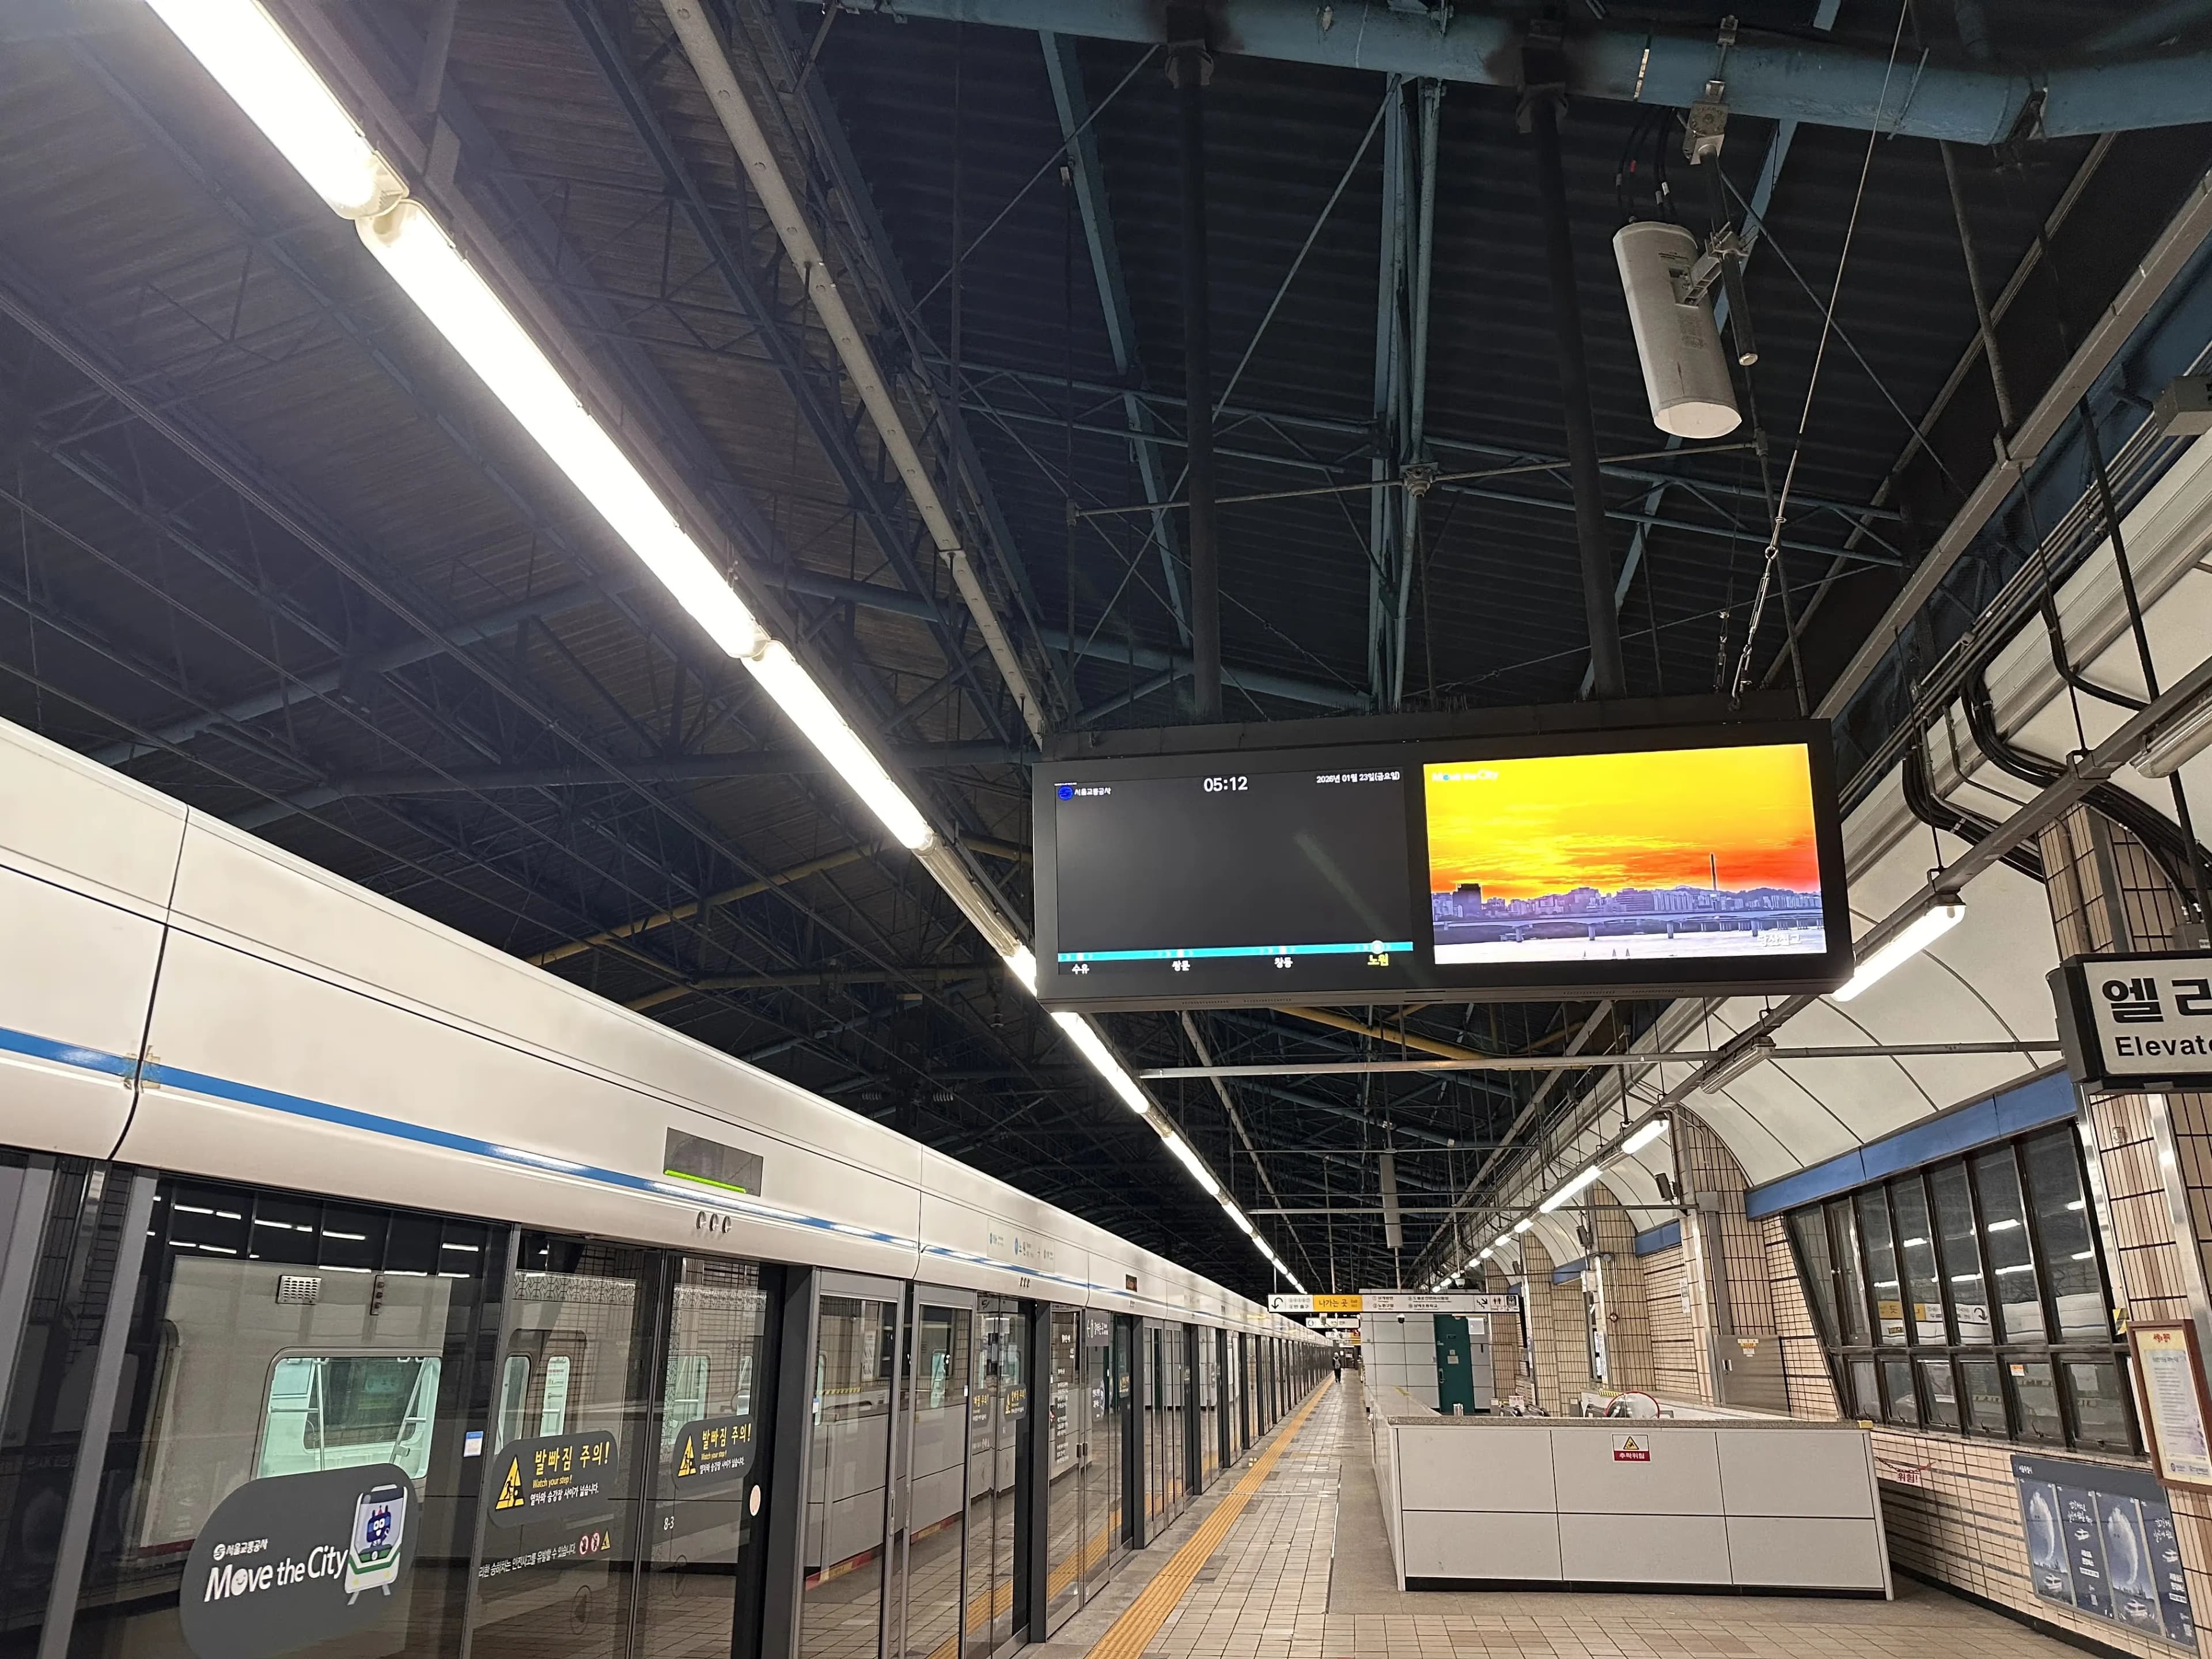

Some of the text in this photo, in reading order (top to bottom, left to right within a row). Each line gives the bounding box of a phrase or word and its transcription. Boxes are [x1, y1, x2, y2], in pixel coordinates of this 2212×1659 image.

[1204, 776, 1248, 792] 05:12
[1316, 771, 1400, 783] 2026년 01월 23일(금요일)
[1274, 957, 1293, 968] 창동
[1368, 953, 1389, 966] 노원
[1071, 964, 1090, 975] 수유
[2115, 1035, 2212, 1056] Elevat
[1319, 1299, 1339, 1308] 나가는
[1341, 1299, 1348, 1308] 곳
[702, 1423, 751, 1450] 발빠짐 주의!
[535, 1441, 609, 1476] 발빠짐 주의!
[532, 1475, 573, 1488] Watch your step!
[1898, 1472, 1918, 1483] 위험!
[530, 1483, 599, 1506] 열차와 승강장 사이가 넓습니다.
[664, 1516, 675, 1531] 8-3
[225, 1538, 268, 1556] 서울교통공사
[204, 1545, 349, 1603] Move the City
[478, 1564, 490, 1578] 리한
